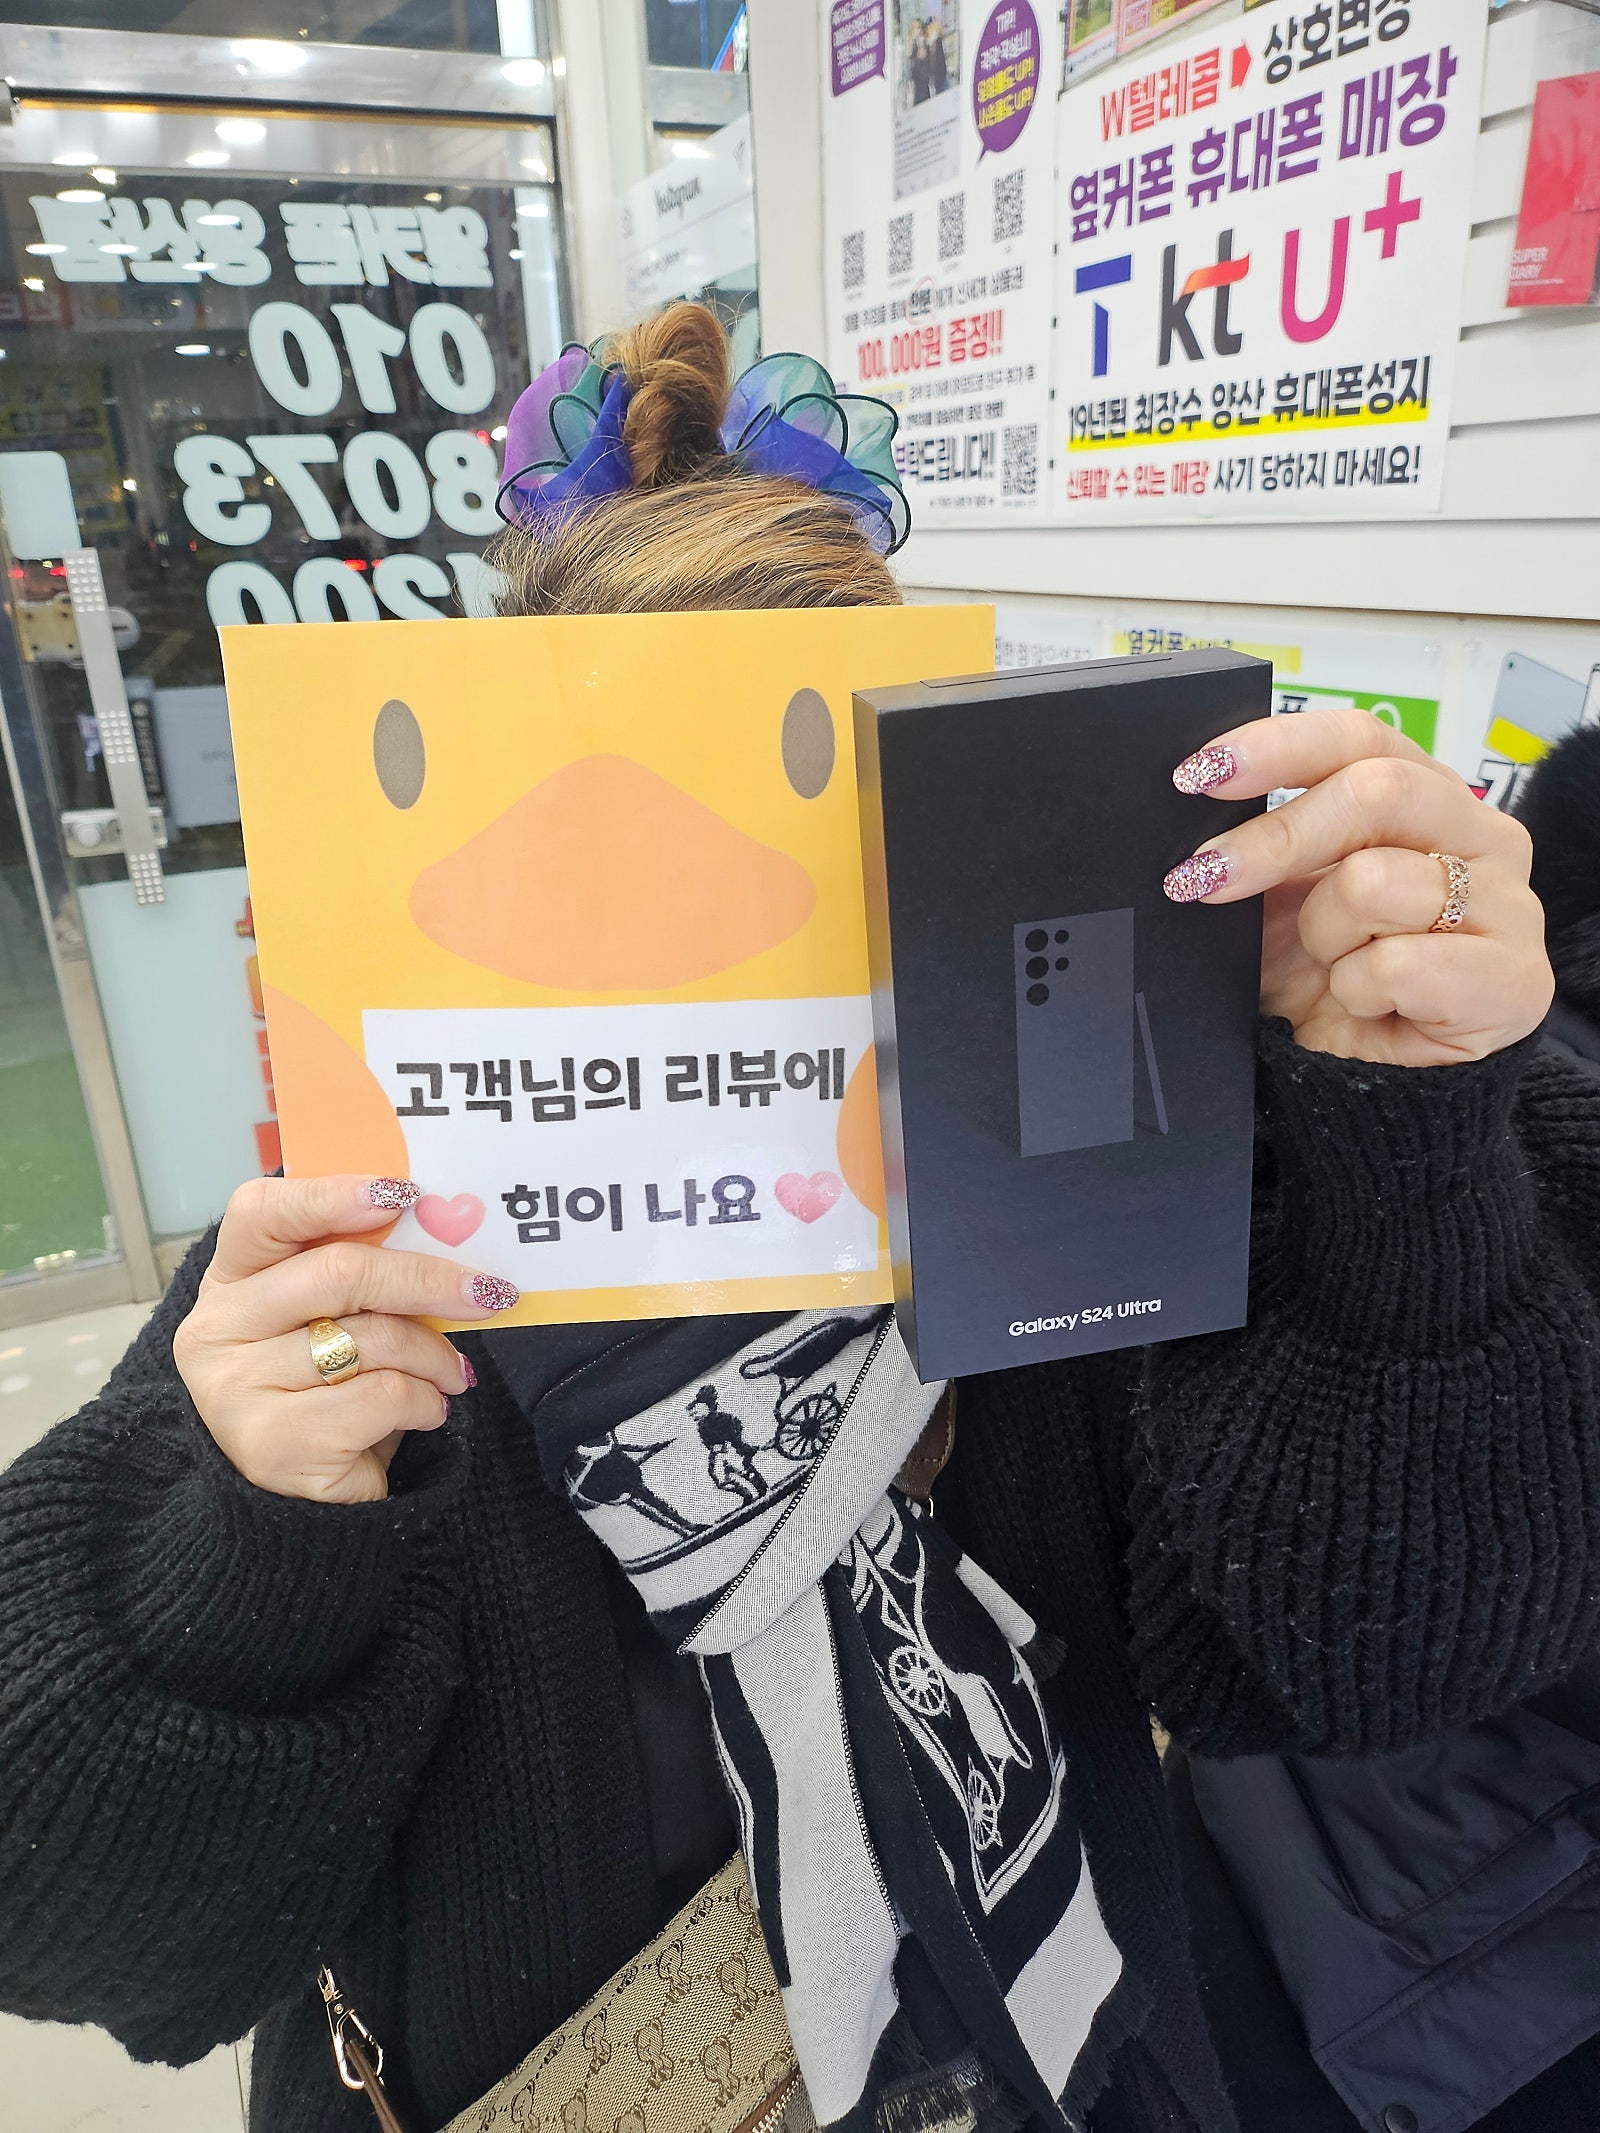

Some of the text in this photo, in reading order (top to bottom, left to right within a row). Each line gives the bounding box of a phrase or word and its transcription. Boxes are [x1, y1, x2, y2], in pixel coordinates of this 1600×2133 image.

[1102, 47, 1221, 142] W텔레콤
[1186, 90, 1325, 208] 휴대폰
[1338, 45, 1459, 160] 매장
[1158, 227, 1251, 366] kt
[1279, 170, 1423, 344] U+
[949, 309, 1004, 364] 증정!!
[1134, 387, 1202, 437] 최장수
[1211, 378, 1265, 430] 양산
[1273, 355, 1432, 422] 휴대폰성지
[1067, 444, 1422, 500] 신뢰할 수 있는 매장 사기 당하지 마세요!
[395, 1047, 846, 1123] 고객님의 리뷰에
[500, 1173, 761, 1244] 힘이 나요
[1008, 1298, 1163, 1337] Galaxy S24 Ultra
